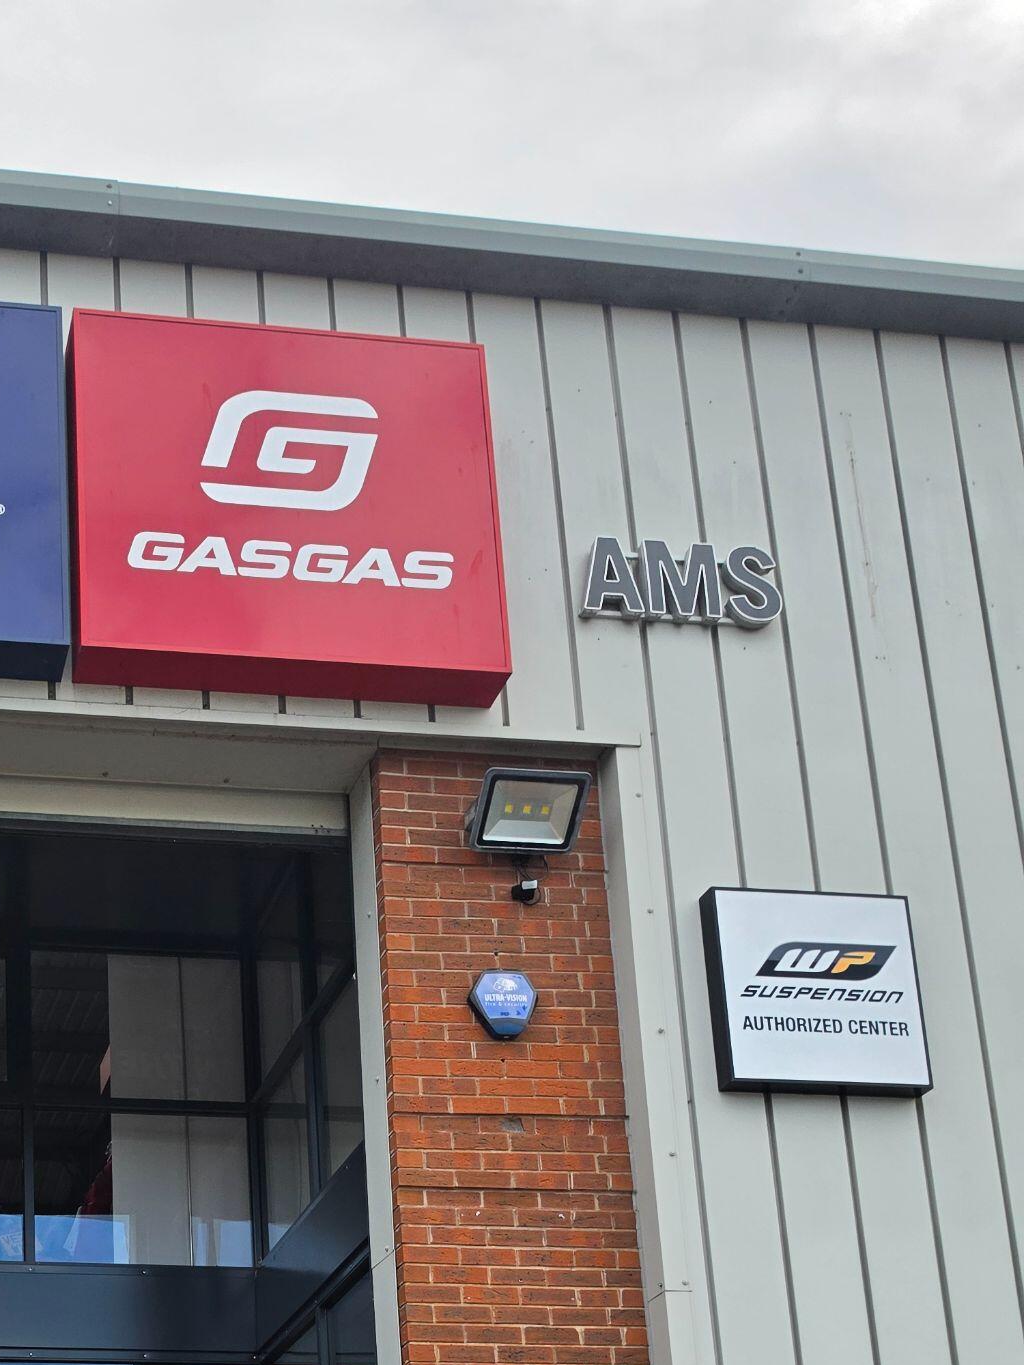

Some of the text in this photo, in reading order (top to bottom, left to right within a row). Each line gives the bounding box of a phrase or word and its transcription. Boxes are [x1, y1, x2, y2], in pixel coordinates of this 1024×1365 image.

[127, 531, 455, 590] GASGAS
[581, 536, 783, 624] AMS
[773, 948, 876, 974] WP
[484, 993, 528, 1003] ULTRA-VISION
[740, 984, 904, 1004] SUSPENSION
[742, 1015, 910, 1037] AUTHORIZED CENTER
